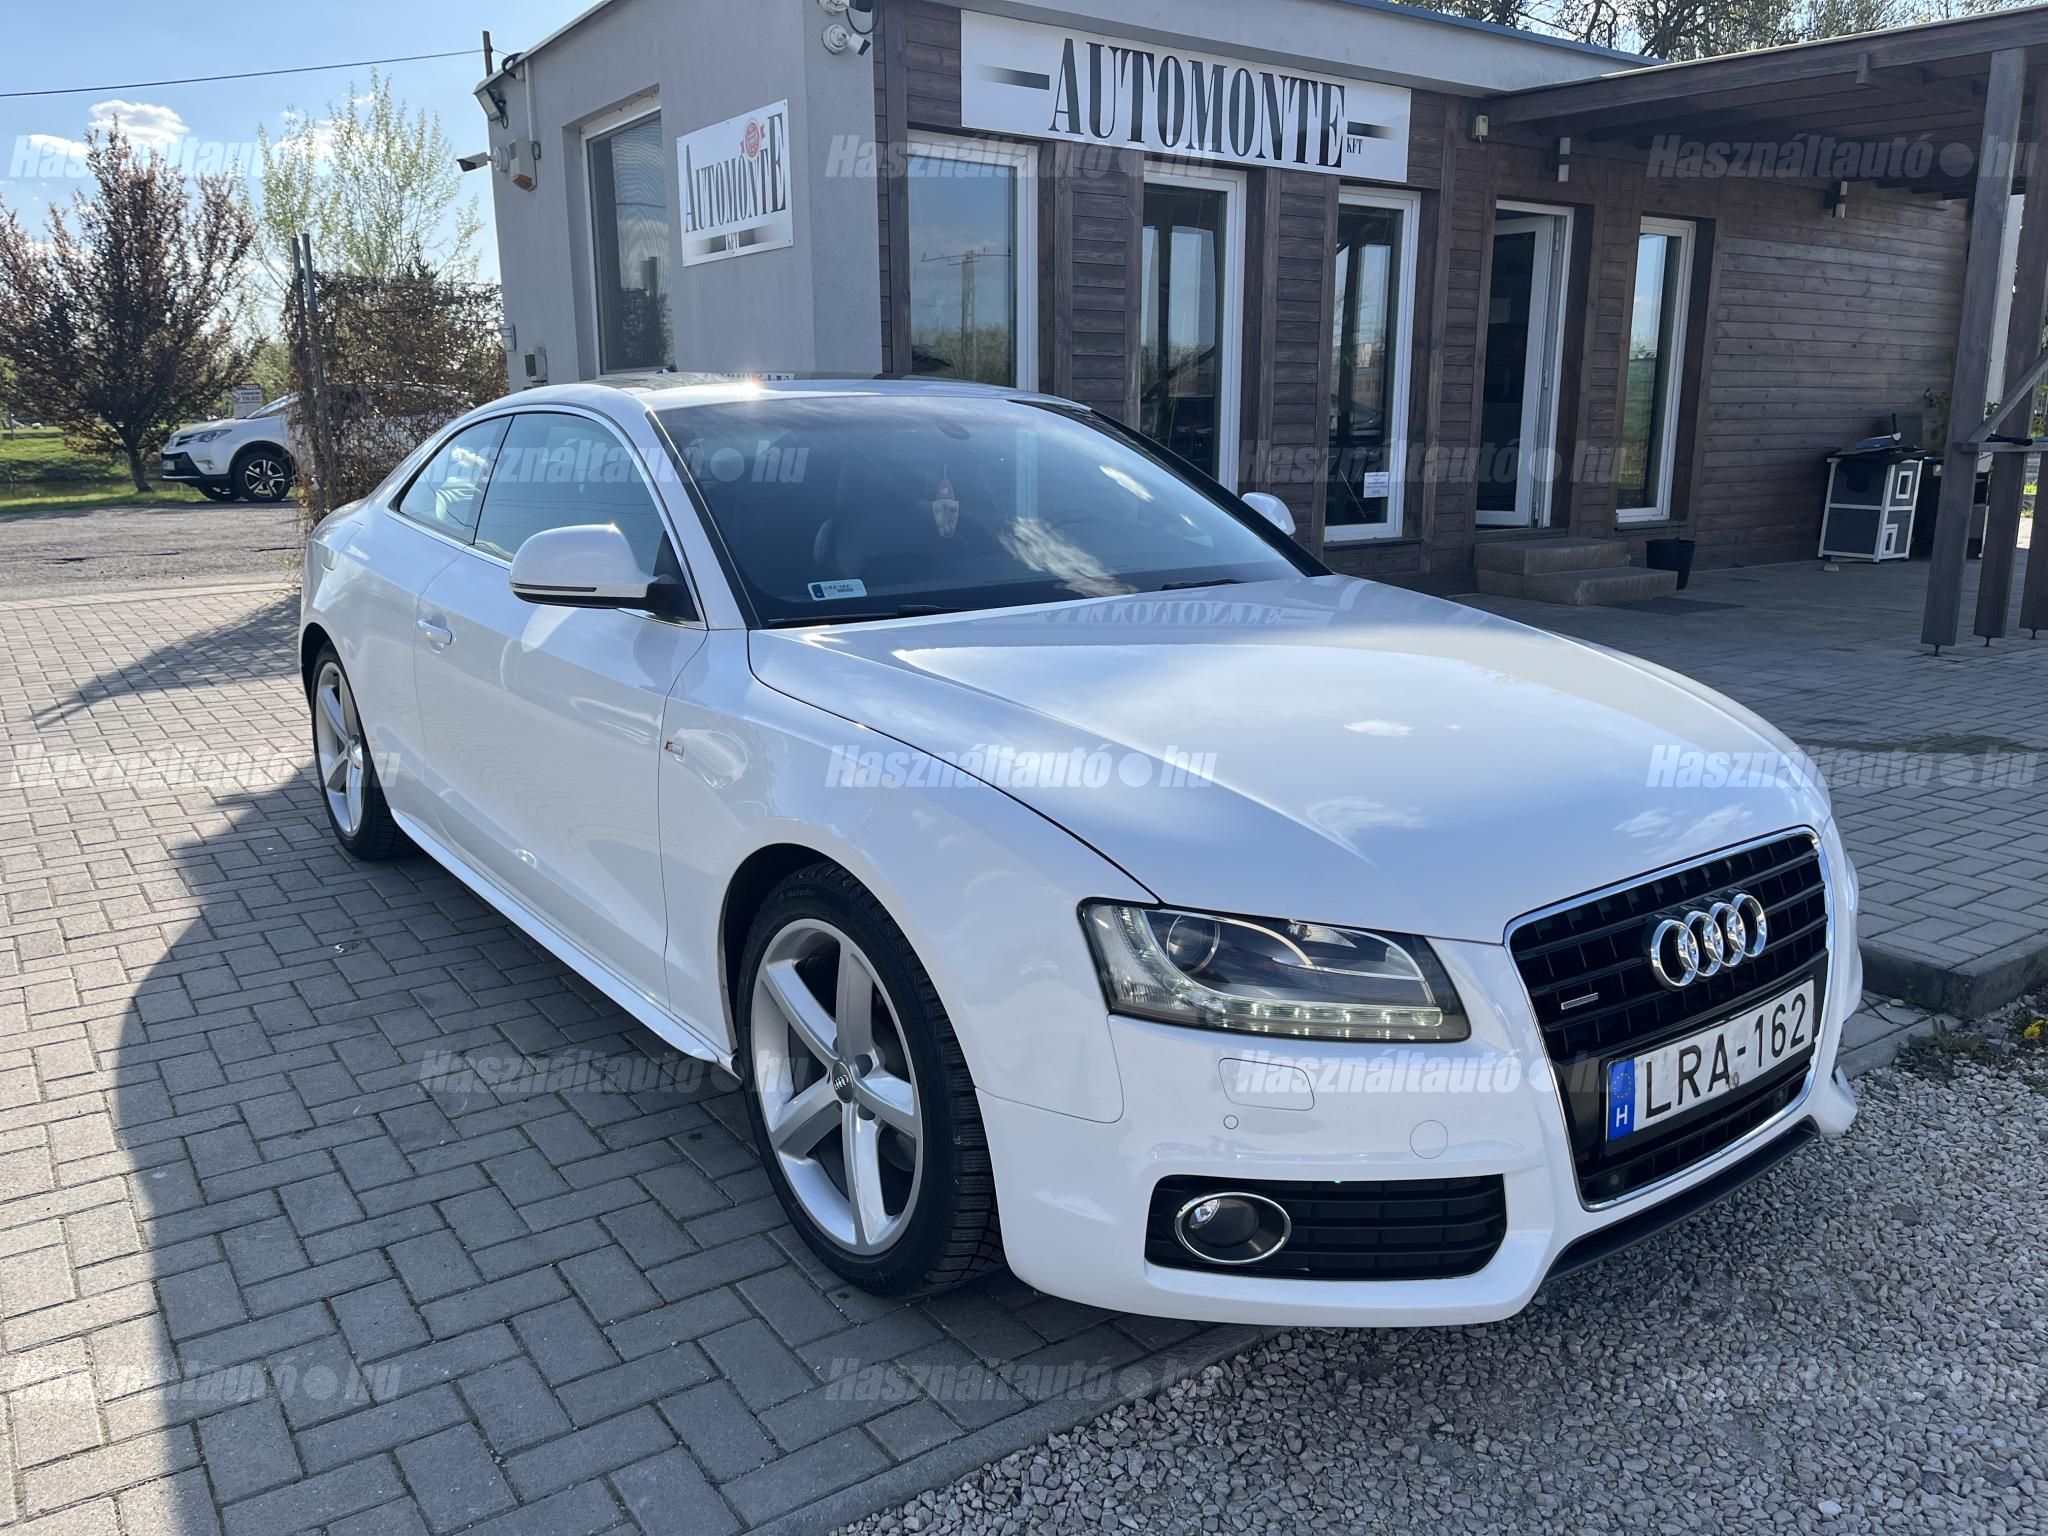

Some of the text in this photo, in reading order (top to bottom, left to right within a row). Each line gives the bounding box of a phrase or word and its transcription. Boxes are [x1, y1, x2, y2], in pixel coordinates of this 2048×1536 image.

[1048, 37, 1346, 168] AUTOMONTE
[1346, 136, 1365, 156] KFT
[685, 112, 787, 234] AUTOMONTE
[1615, 1104, 1629, 1128] H
[1645, 992, 1806, 1119] LRA-162
